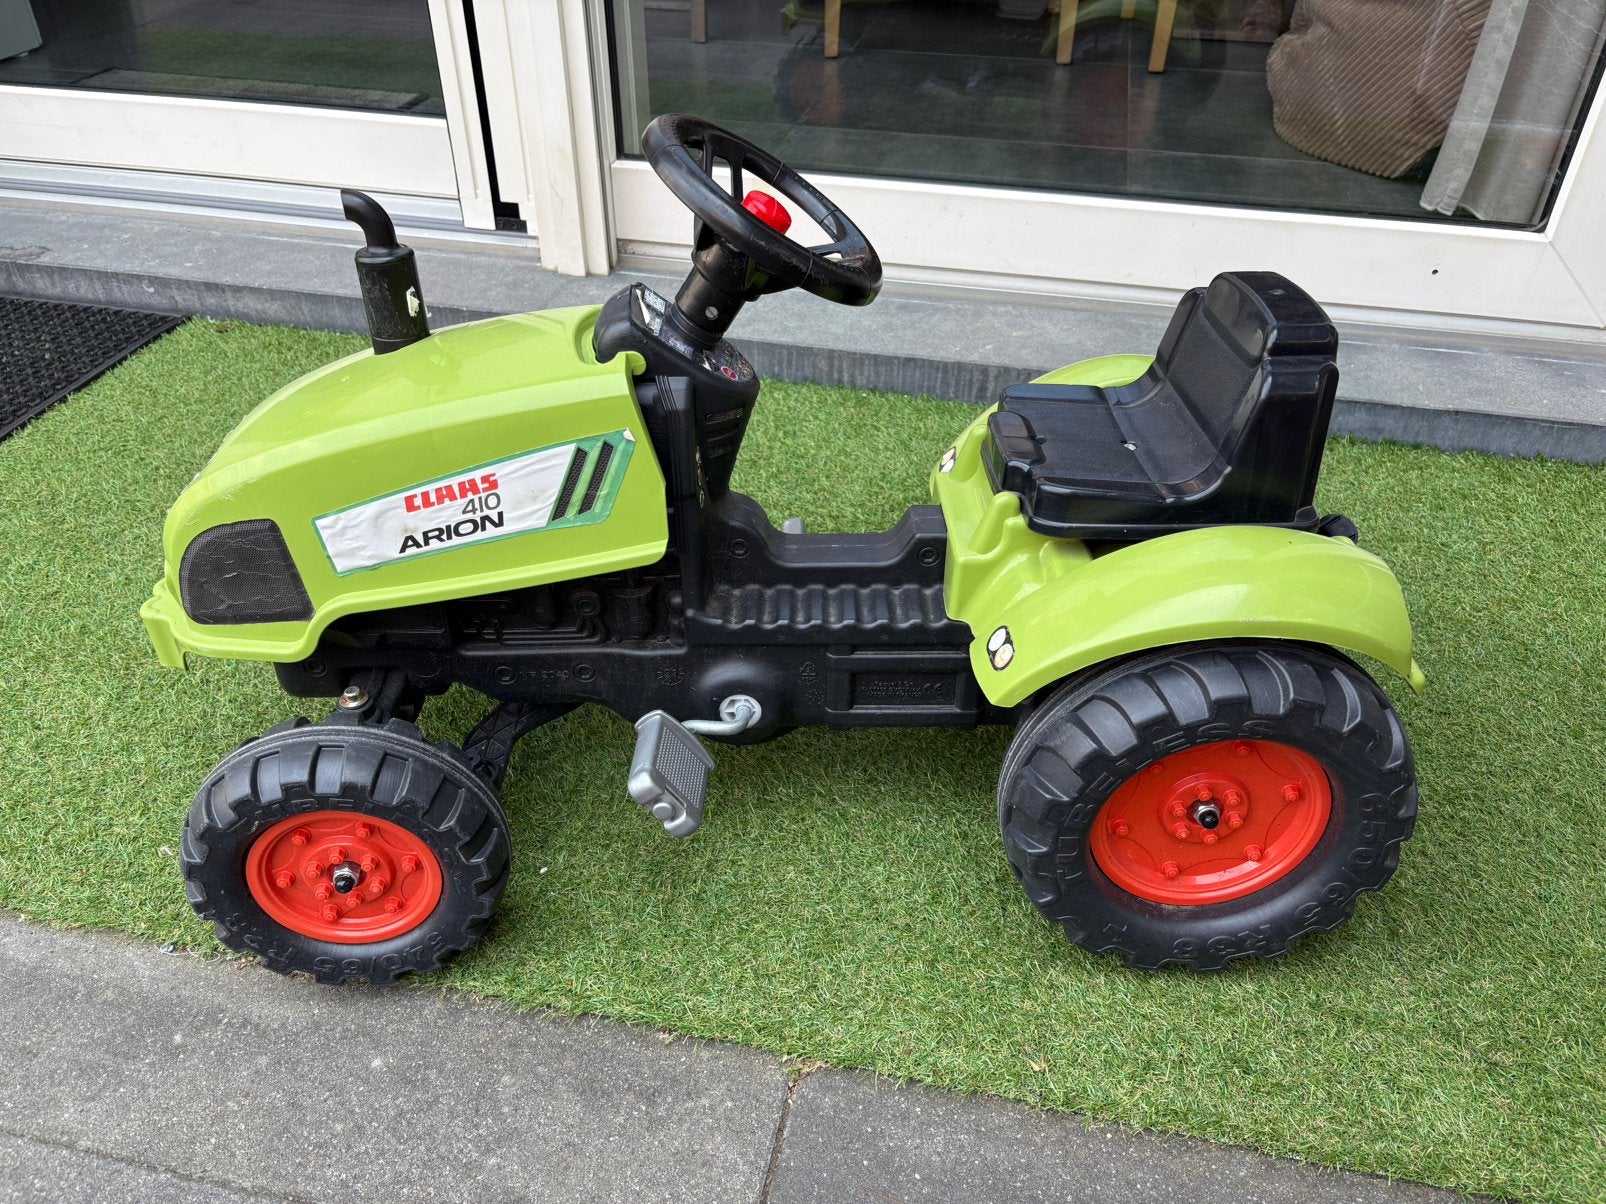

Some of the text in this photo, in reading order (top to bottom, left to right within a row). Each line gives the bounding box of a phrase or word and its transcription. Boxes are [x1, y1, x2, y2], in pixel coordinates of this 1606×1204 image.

[404, 473, 499, 512] CLAAS
[461, 492, 500, 514] 410
[398, 511, 504, 554] ARION
